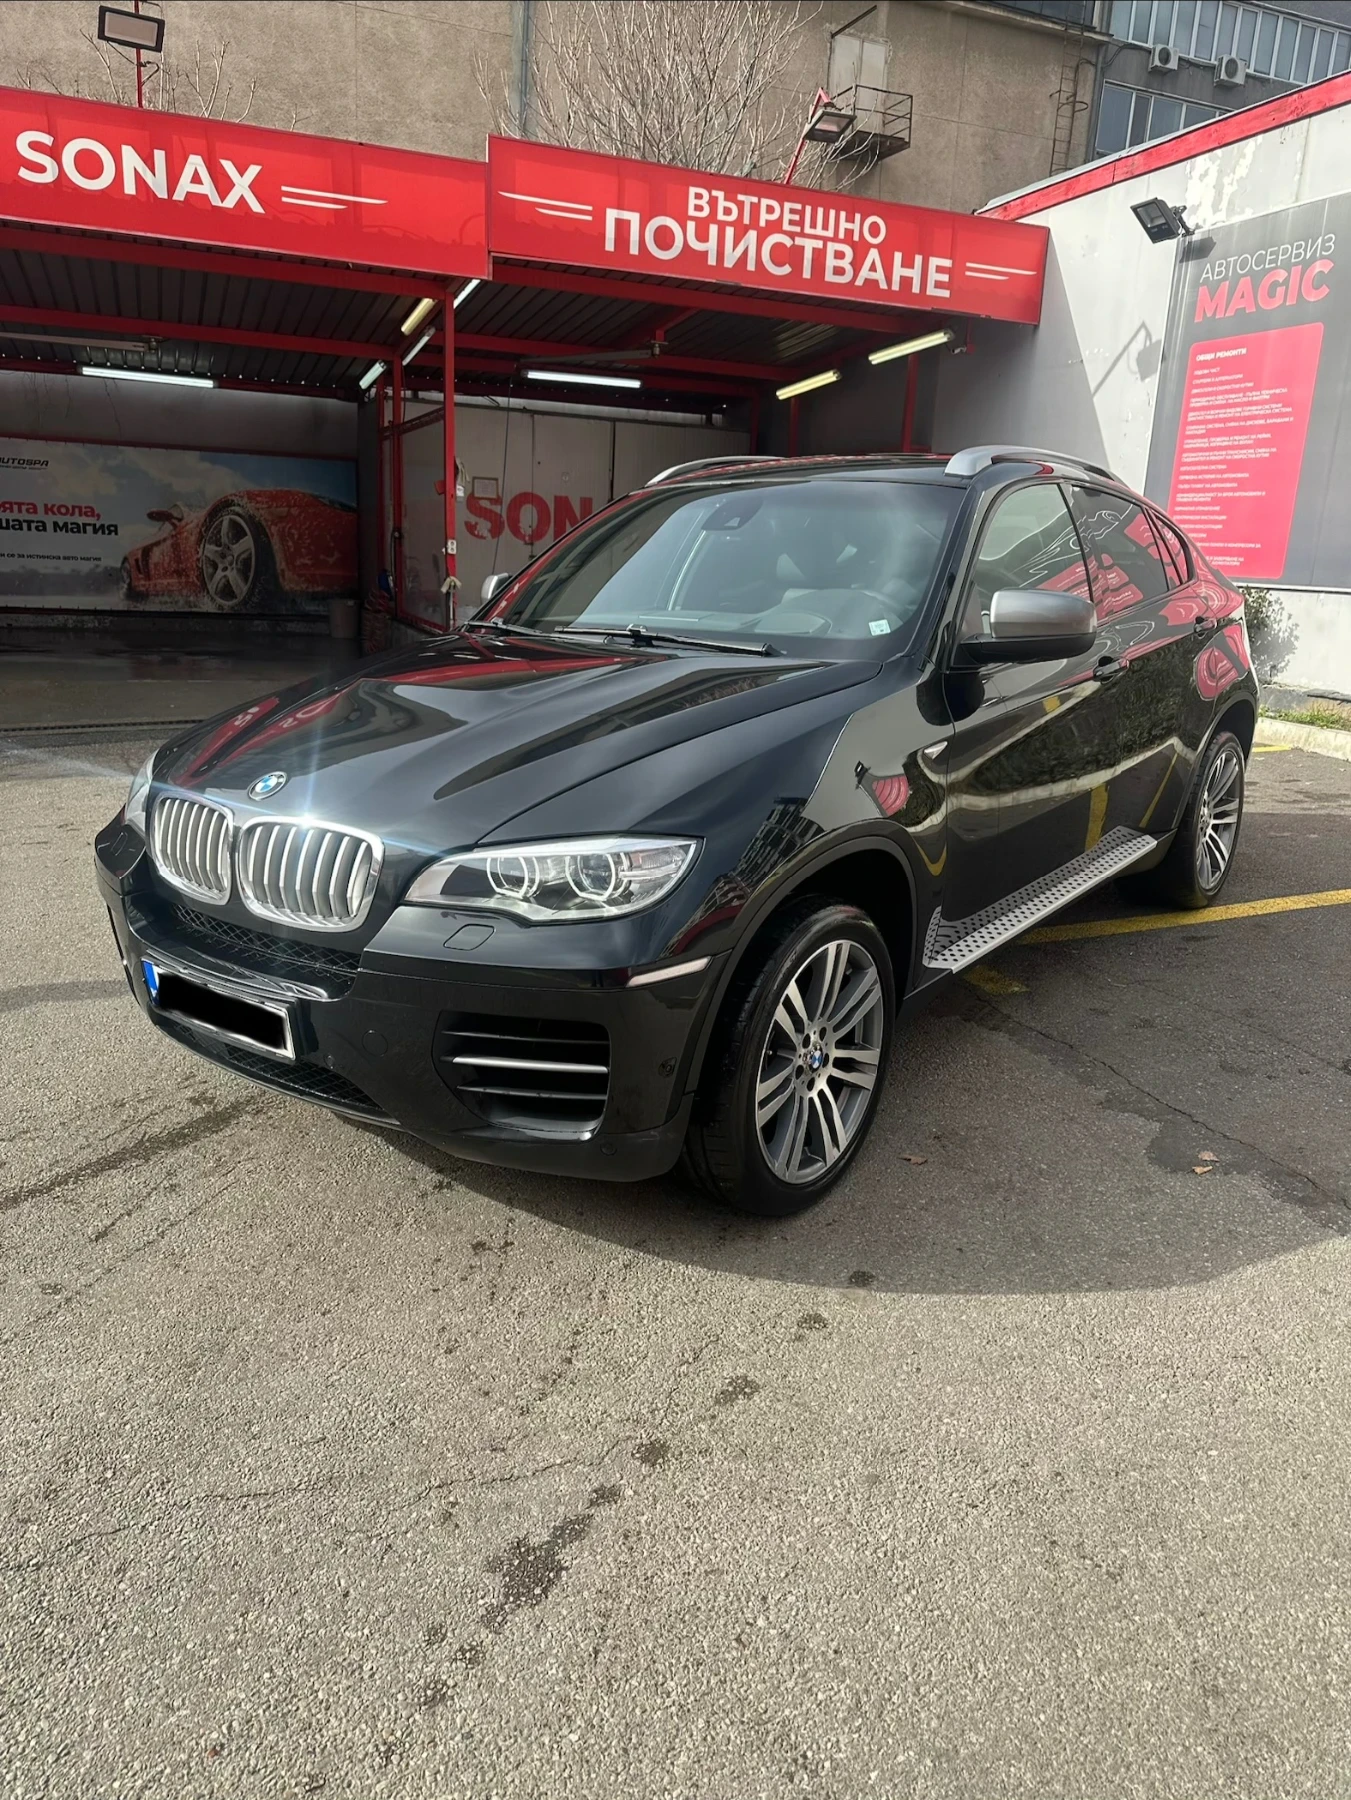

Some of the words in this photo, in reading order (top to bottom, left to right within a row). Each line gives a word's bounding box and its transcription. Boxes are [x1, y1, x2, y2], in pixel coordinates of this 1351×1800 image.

[15, 130, 266, 214] SONAX
[688, 186, 887, 245] ВЪТРЕШНО
[604, 208, 953, 298] ПОЧИСТВАНЕ
[1200, 233, 1336, 283] АВТОСЕРВИЗ
[1194, 258, 1335, 323] MAGIC
[1196, 352, 1215, 361] ОБЩИ
[1216, 348, 1247, 358] РЕМОНТИ
[0, 456, 49, 467] UTOSPA
[0, 501, 38, 515] ята
[43, 503, 102, 521] кола,
[53, 520, 119, 536] магия
